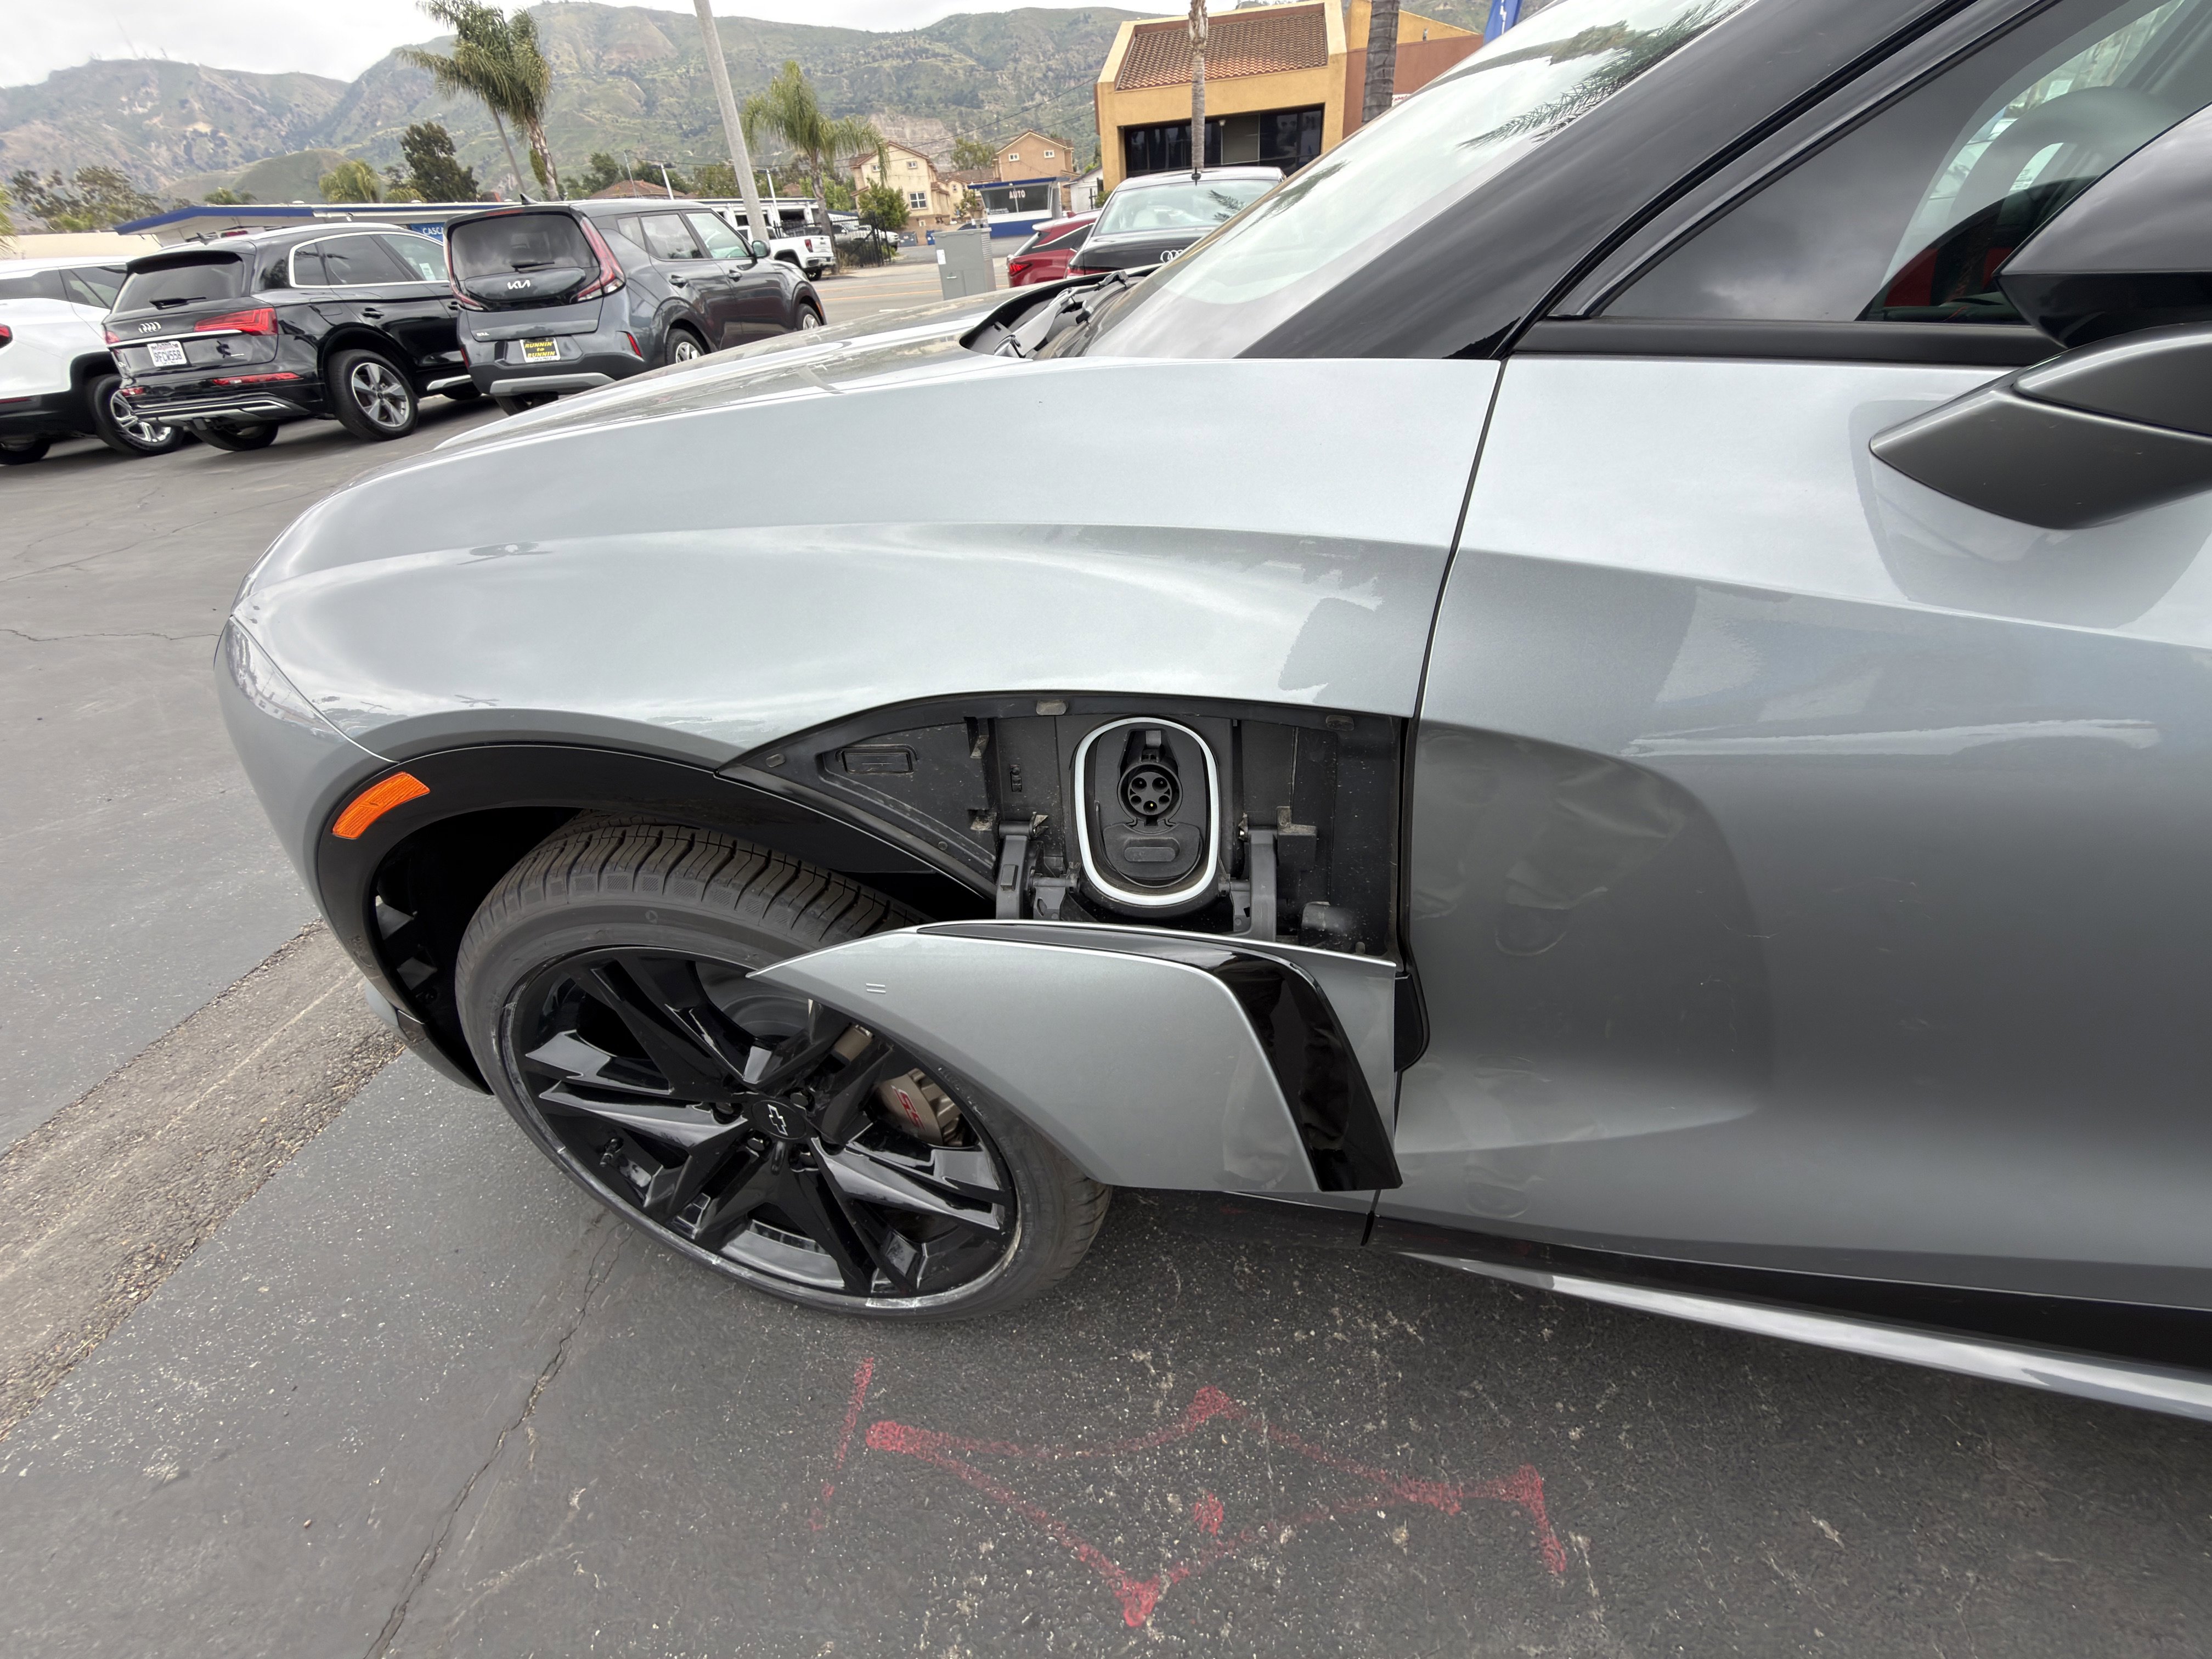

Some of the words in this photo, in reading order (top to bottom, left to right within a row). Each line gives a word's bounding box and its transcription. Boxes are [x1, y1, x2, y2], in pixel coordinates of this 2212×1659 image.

[1009, 189, 1025, 199] AUTO
[507, 280, 531, 289] KIA
[891, 1085, 926, 1132] SS
